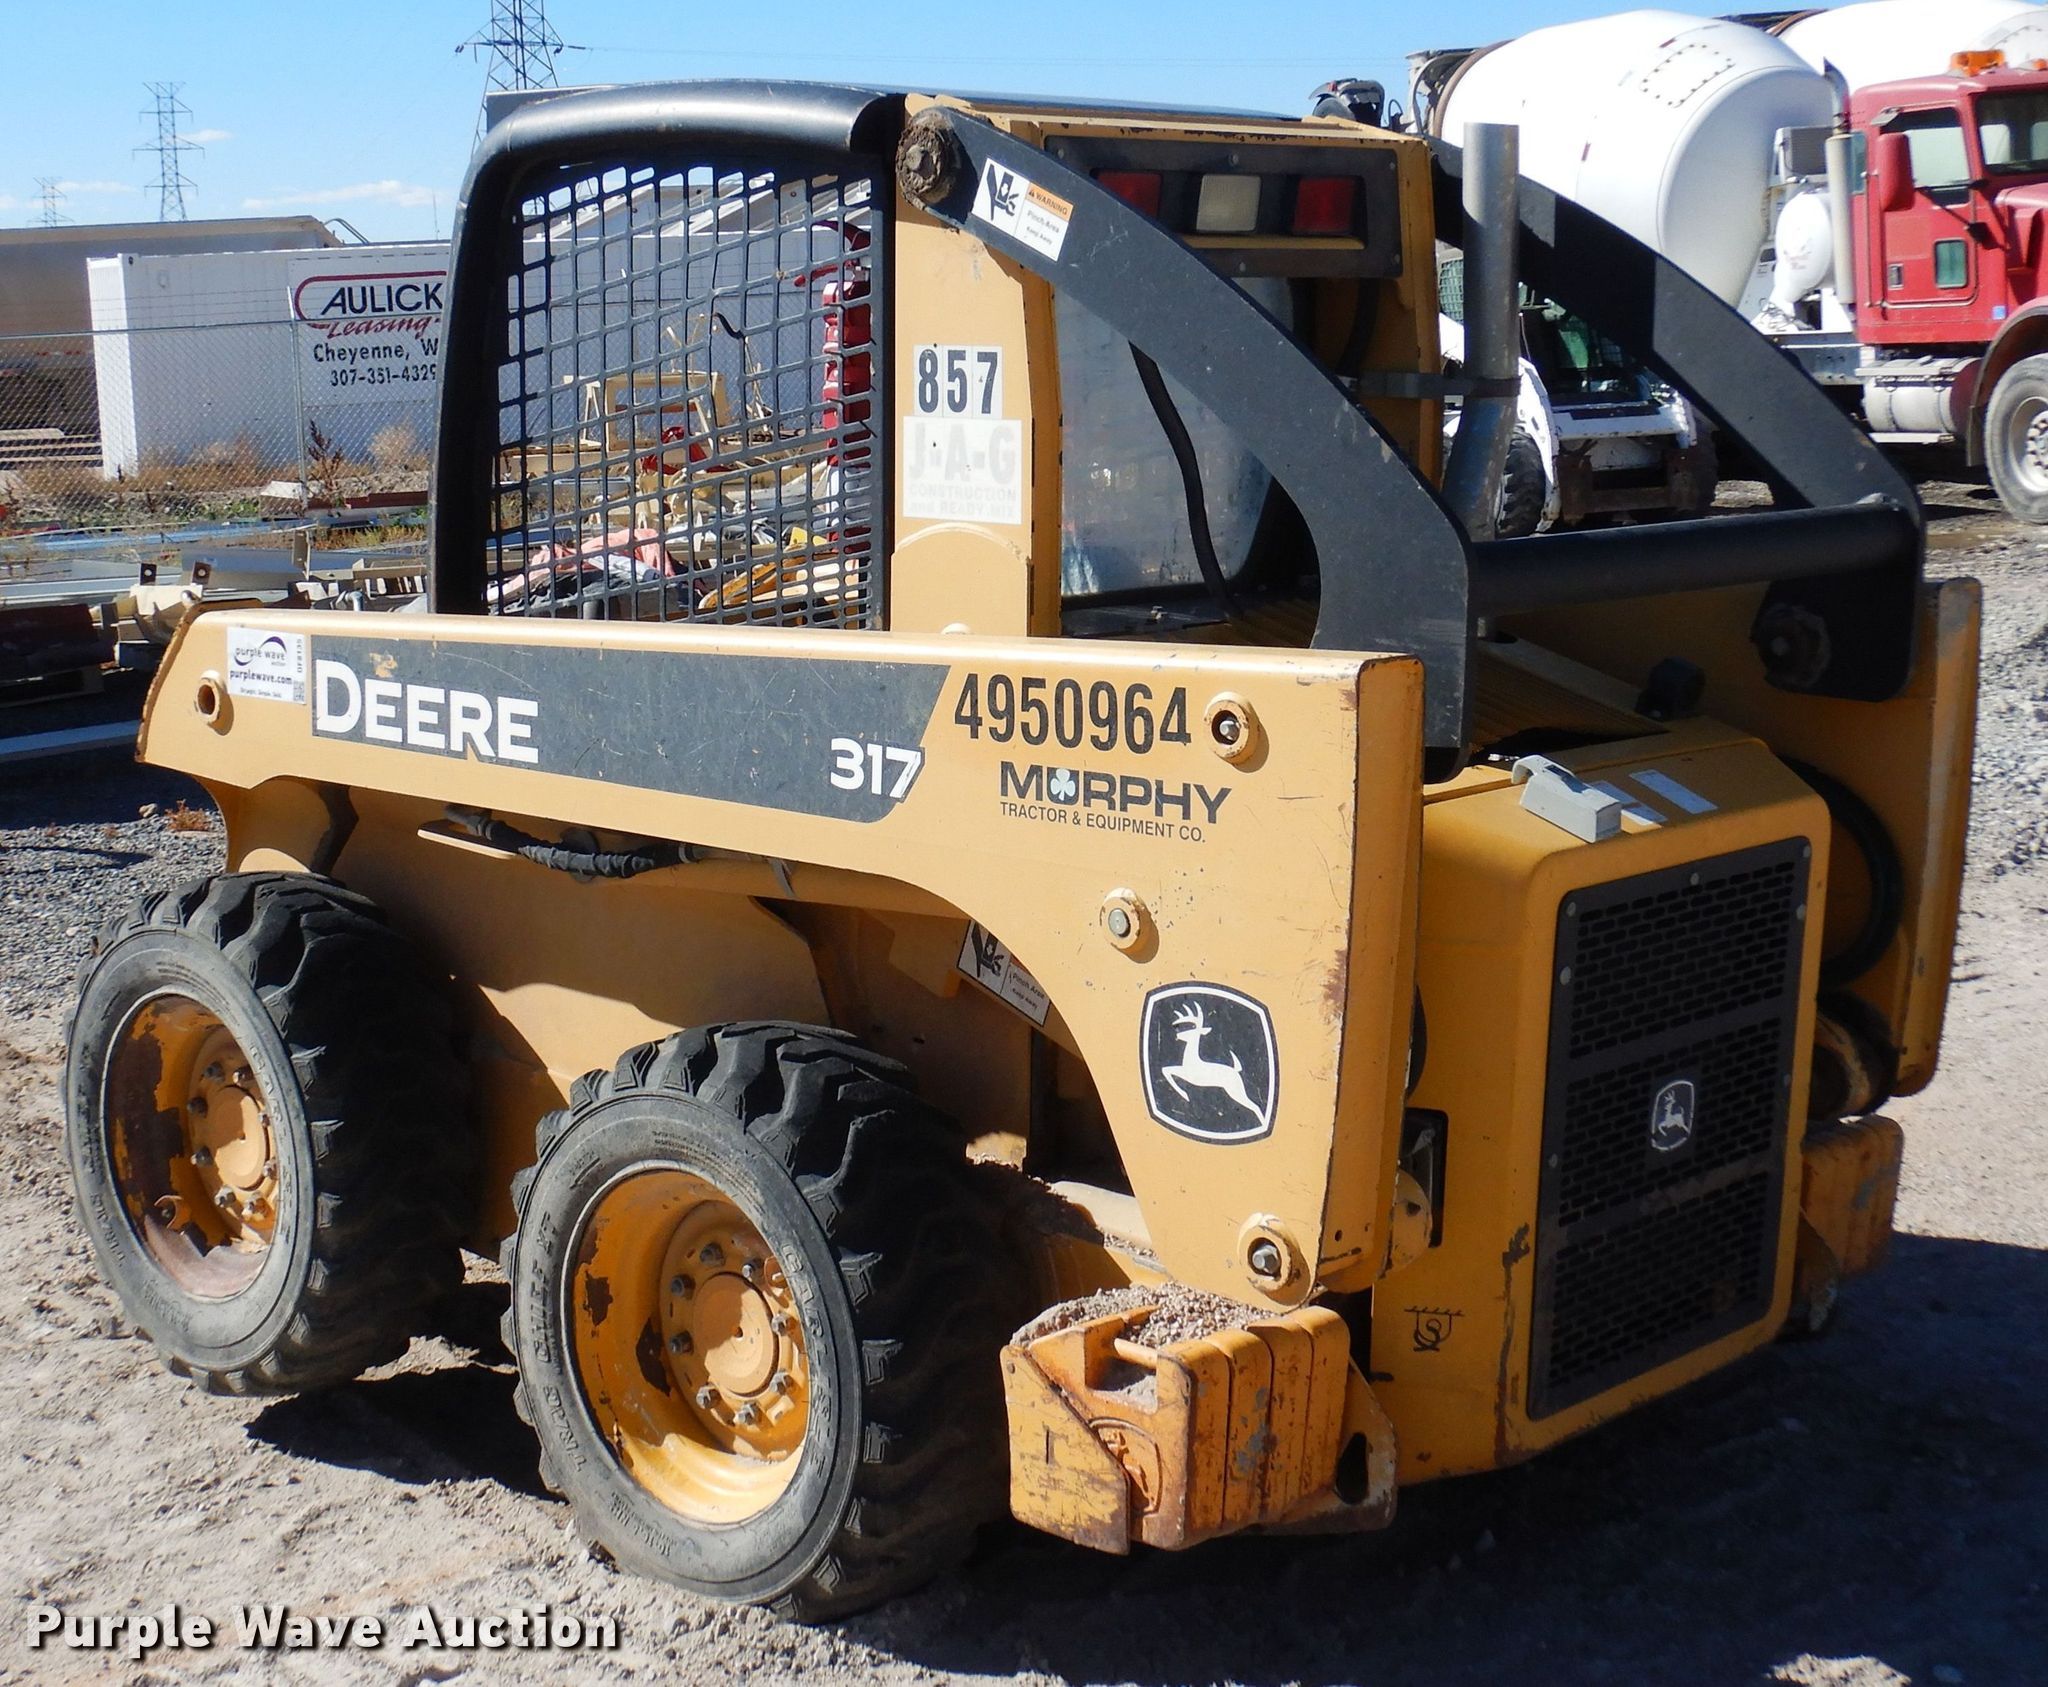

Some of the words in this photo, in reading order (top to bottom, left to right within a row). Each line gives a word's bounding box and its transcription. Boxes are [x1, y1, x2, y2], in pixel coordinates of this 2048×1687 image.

[1036, 195, 1068, 216] WARNING
[320, 283, 443, 315] AULICK
[327, 316, 433, 340] Leasing
[313, 342, 410, 365] Cheyenne,
[421, 337, 439, 357] W
[918, 349, 998, 415] 857
[235, 647, 262, 659] purple
[264, 651, 286, 661] wave
[230, 669, 292, 685] purplewave.com
[315, 659, 539, 764] DEERE
[954, 673, 1192, 754] 4950964
[830, 737, 922, 799] 317
[1000, 801, 1067, 825] TRACTOR
[1071, 811, 1081, 826] &
[1086, 813, 1175, 839] EQUIPMENT
[1179, 824, 1206, 843] CO.
